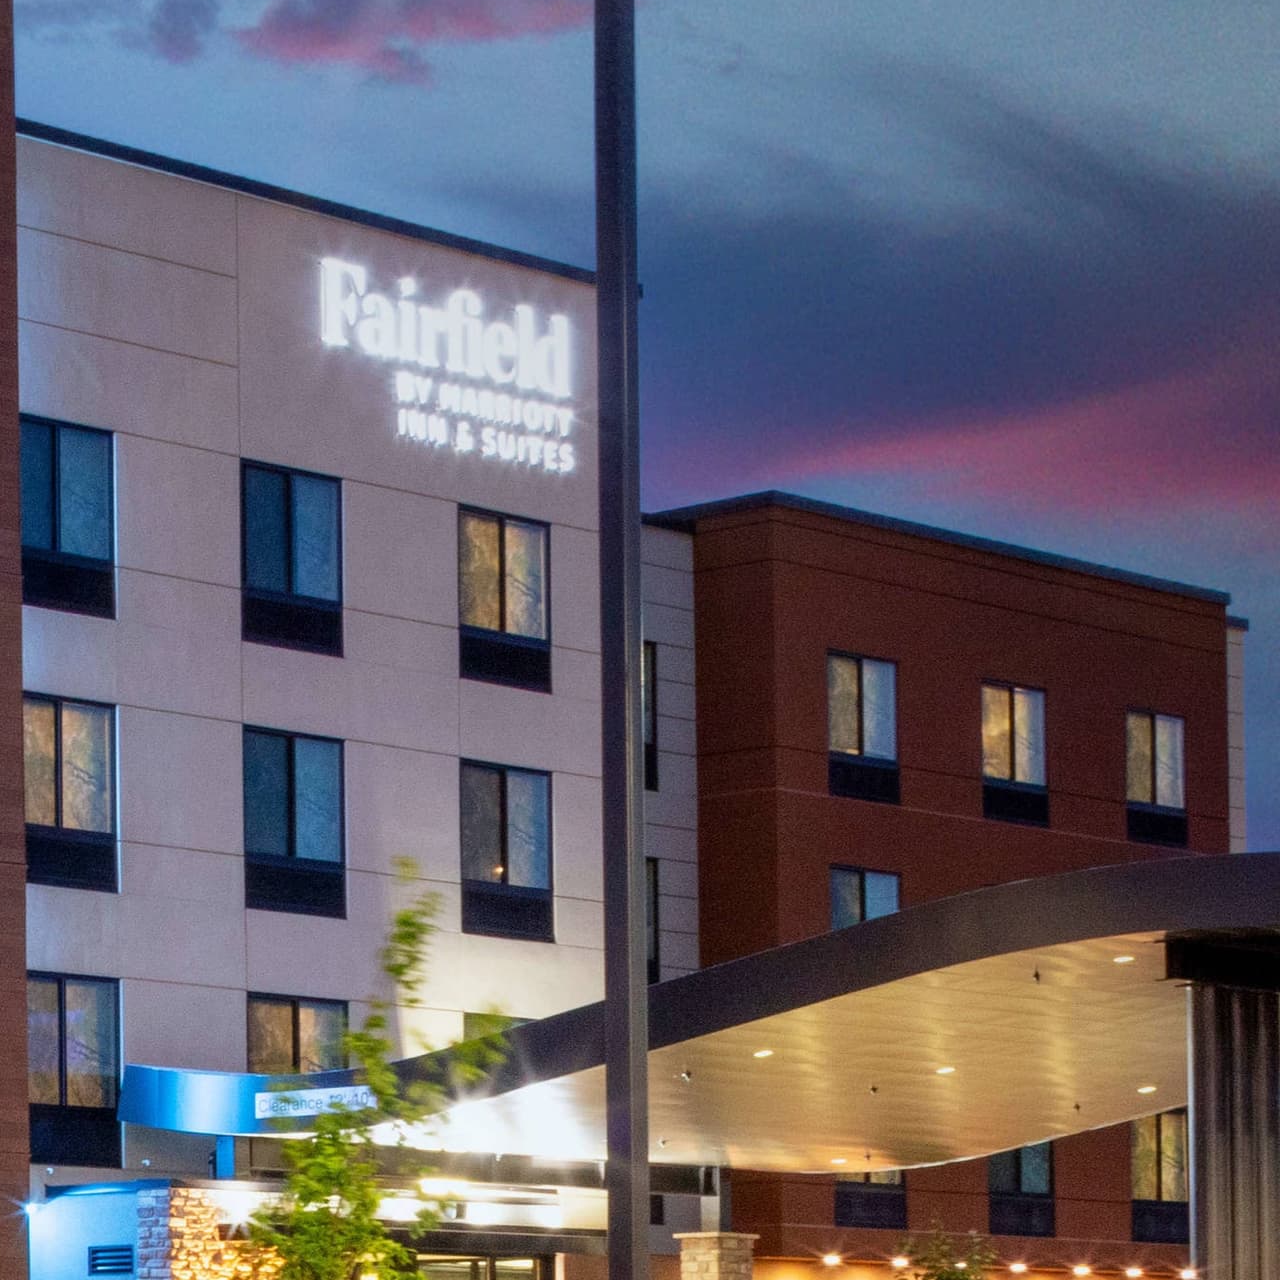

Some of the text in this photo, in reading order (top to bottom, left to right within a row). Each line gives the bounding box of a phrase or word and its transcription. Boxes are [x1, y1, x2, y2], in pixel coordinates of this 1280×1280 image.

[320, 256, 572, 398] Fairfield
[395, 370, 575, 437] BY MARRIOTT
[397, 408, 576, 473] INN & SUITES
[259, 1096, 324, 1114] Clearance
